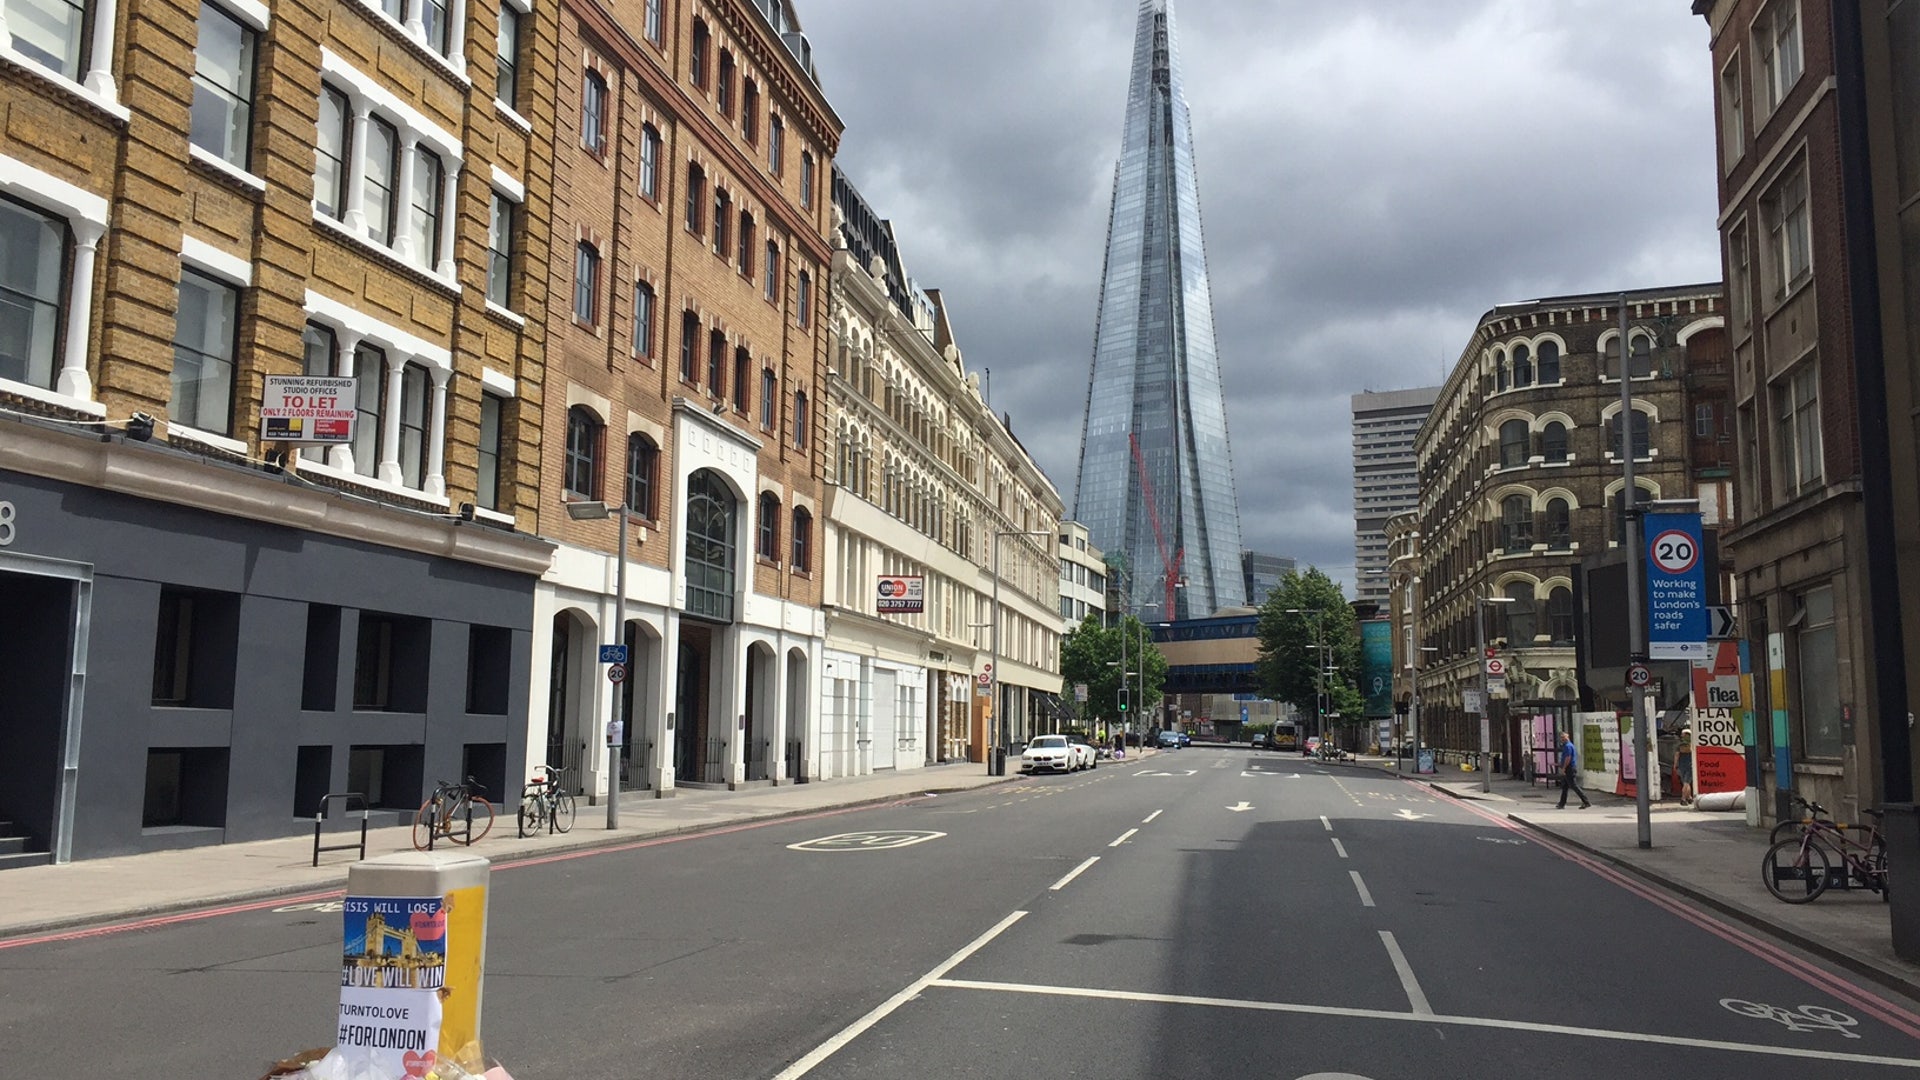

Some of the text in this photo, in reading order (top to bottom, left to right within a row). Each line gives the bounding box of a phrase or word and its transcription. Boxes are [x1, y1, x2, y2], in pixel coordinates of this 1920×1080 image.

[270, 378, 352, 388] STUNNING REFURBISHED
[310, 387, 337, 395] OFFICES
[282, 396, 337, 409] TO LET
[263, 408, 281, 416] ONLY
[288, 408, 314, 417] FLOORS
[316, 409, 354, 418] REMAINING
[0, 501, 15, 545] 8
[1659, 543, 1691, 561] 20
[1653, 580, 1696, 590] Working
[1653, 590, 1696, 599] to make
[878, 600, 890, 608] 020
[1654, 600, 1700, 609] London's
[1655, 610, 1684, 620] roads
[1655, 621, 1681, 630] safer
[611, 669, 623, 679] 20
[1632, 671, 1648, 681] 20
[1709, 686, 1739, 703] flea
[1697, 708, 1733, 719] FLAT
[1698, 720, 1736, 733] IRON
[1700, 760, 1719, 768] Food
[1700, 770, 1726, 778] Drinks
[816, 834, 919, 846] 20
[346, 902, 436, 914] ISIS WILL LOSE
[342, 966, 444, 988] #LOVE WILL WIN
[340, 1003, 409, 1020] TURNTOLOVE
[339, 1025, 426, 1050] #FORLONDON
